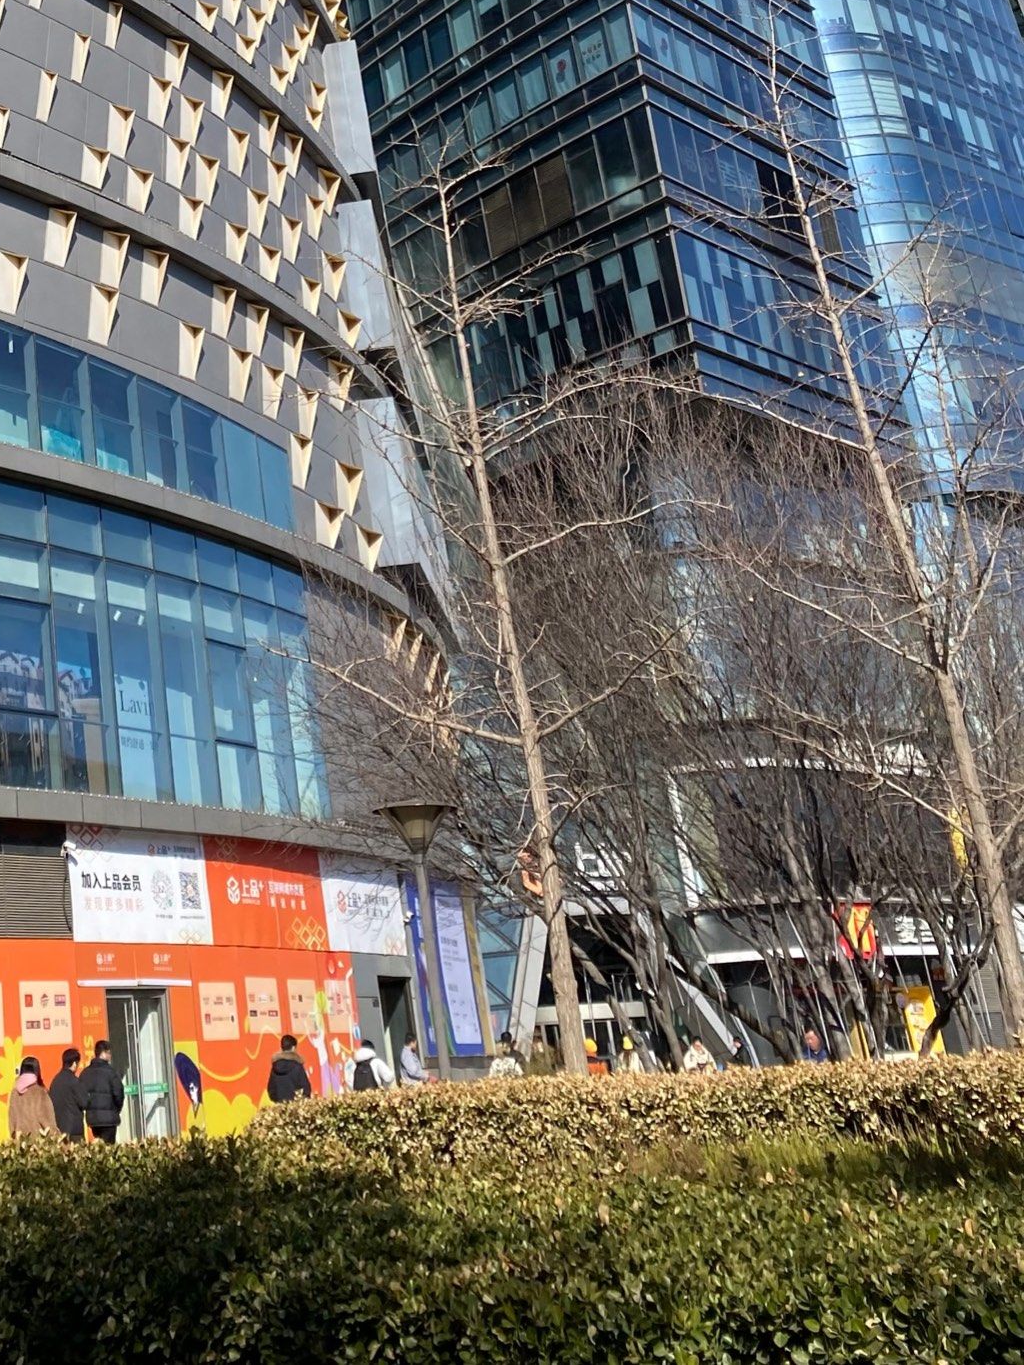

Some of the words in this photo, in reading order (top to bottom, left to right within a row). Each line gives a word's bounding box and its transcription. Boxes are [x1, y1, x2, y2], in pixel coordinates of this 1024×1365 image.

[81, 870, 143, 892] 加入上品会员
